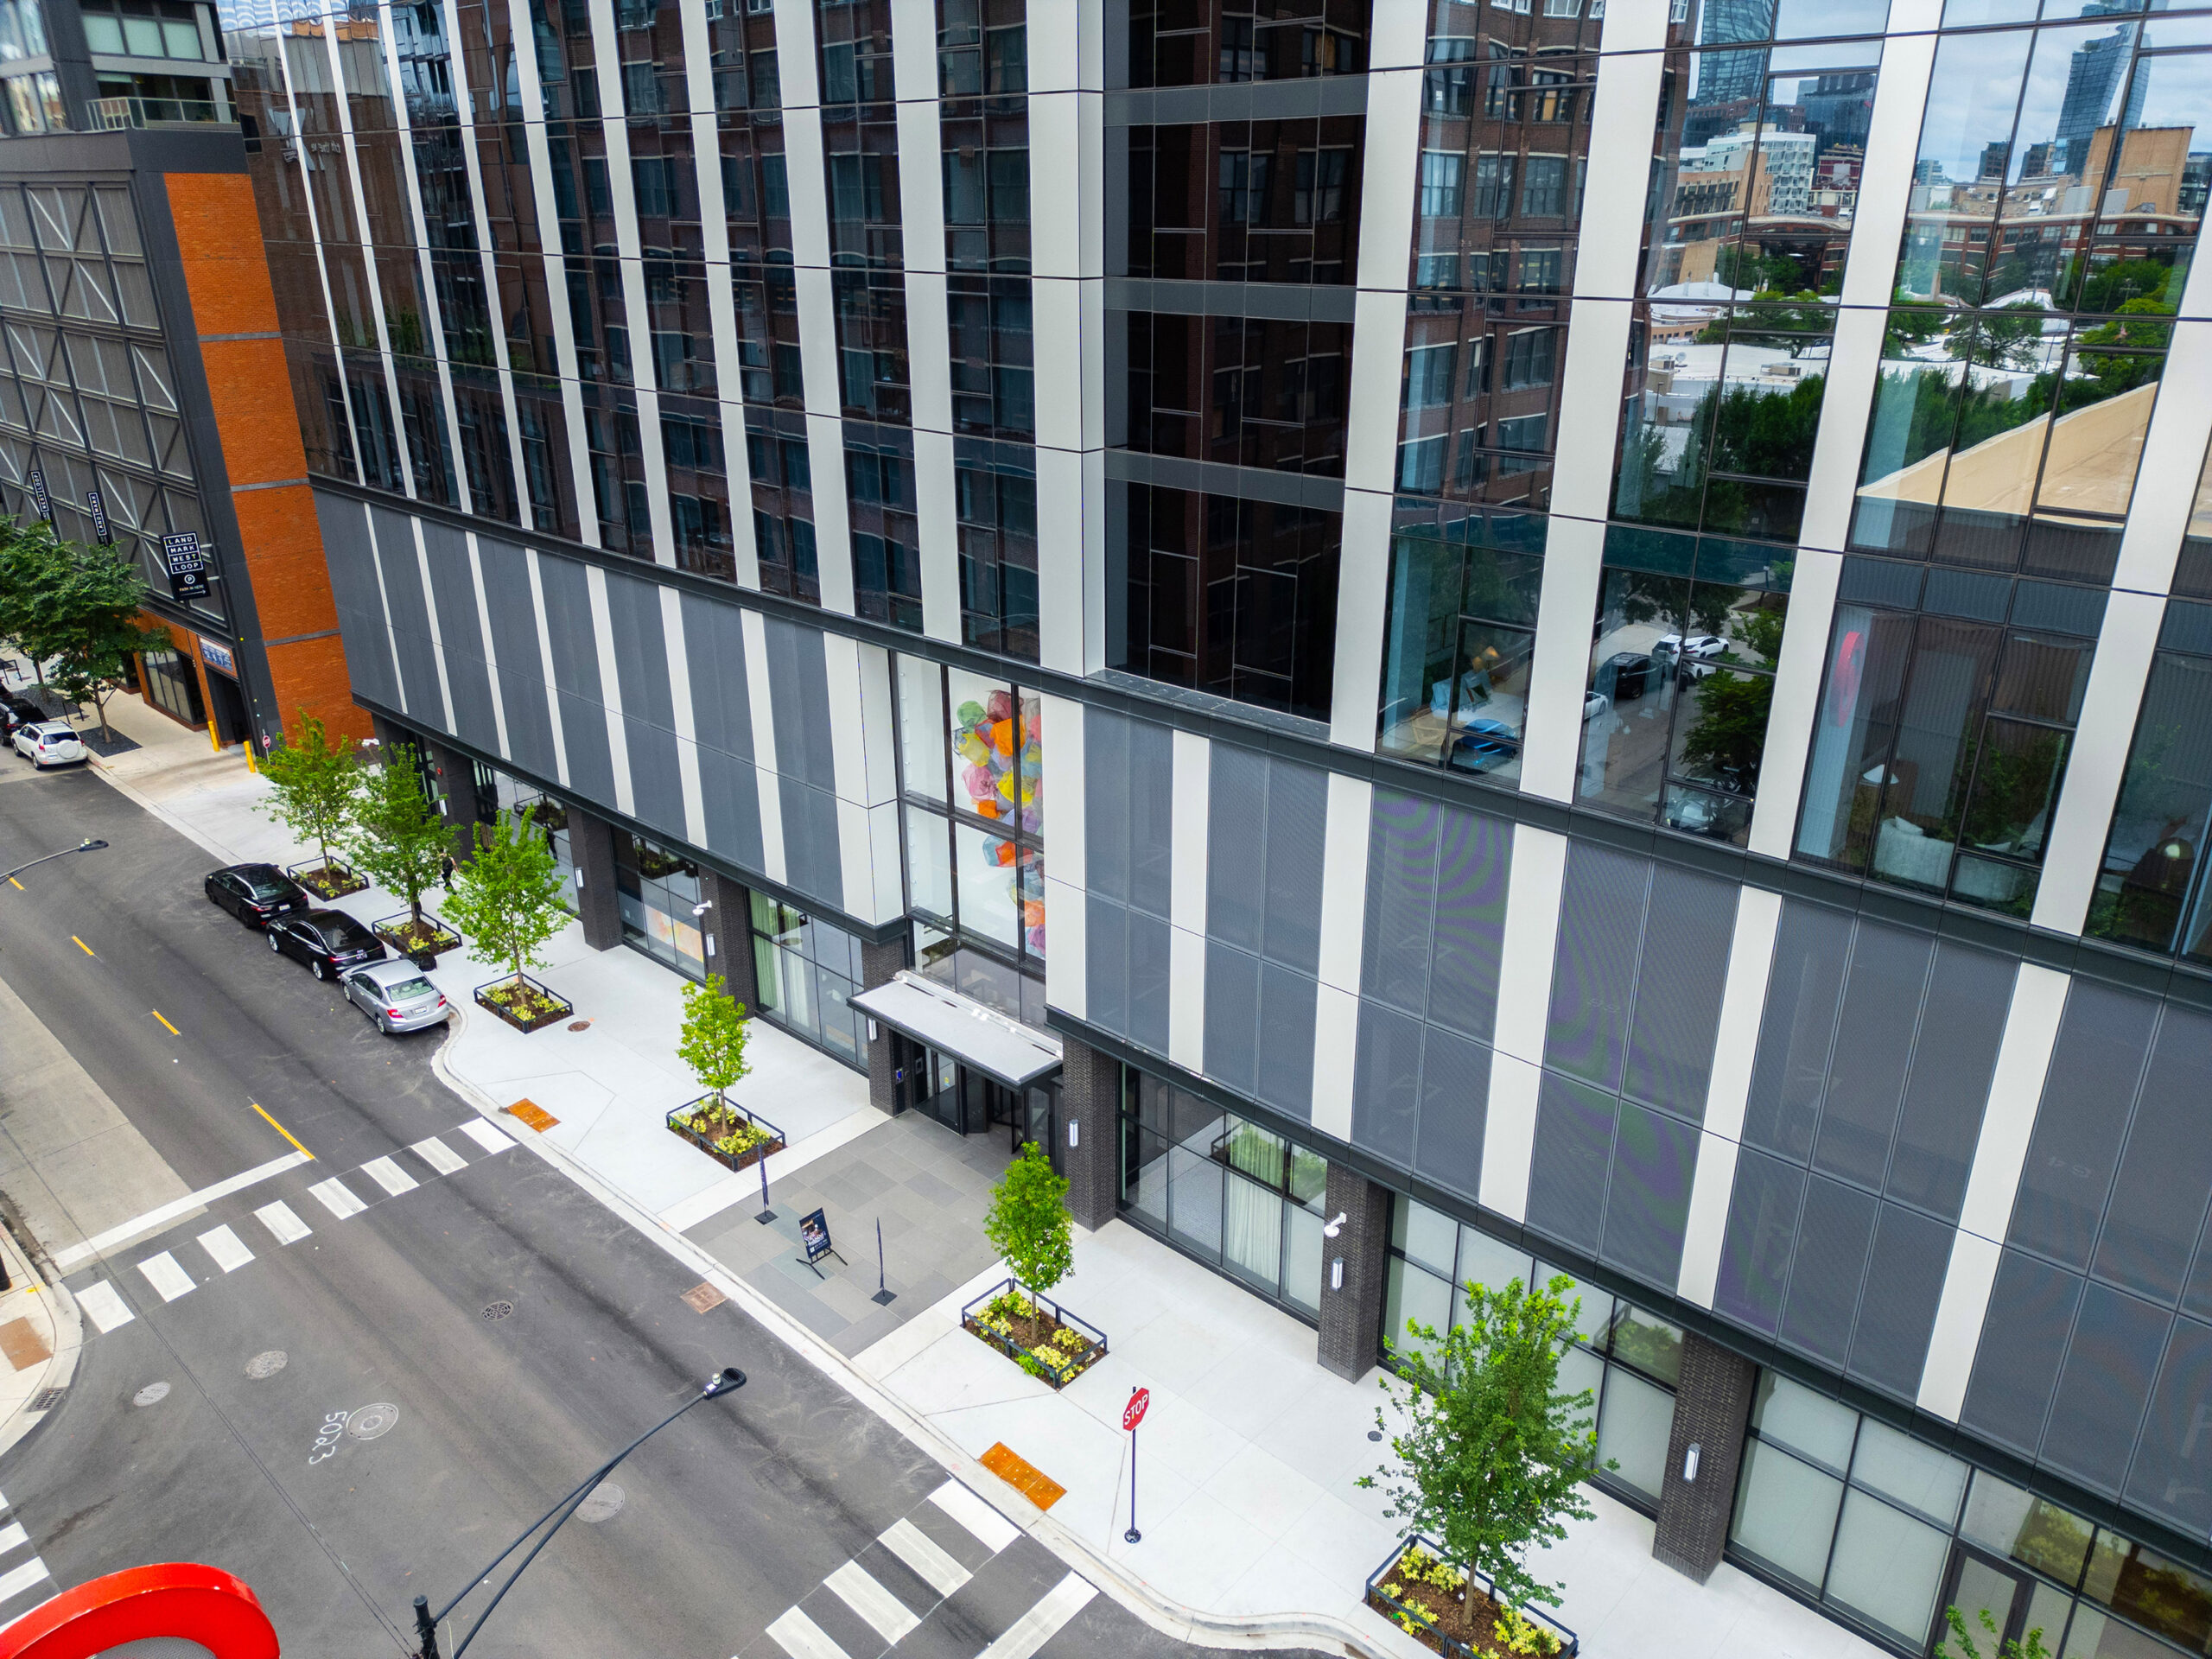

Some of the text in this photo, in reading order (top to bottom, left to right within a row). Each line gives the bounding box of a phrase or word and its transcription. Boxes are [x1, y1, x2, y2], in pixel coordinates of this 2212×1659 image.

[91, 495, 99, 512] MARK
[96, 516, 105, 533] LAND
[170, 544, 195, 554] MARK
[172, 553, 197, 563] WEST
[175, 563, 199, 571] LOOP
[1124, 1394, 1148, 1426] STOP
[308, 1411, 347, 1465] 5023
